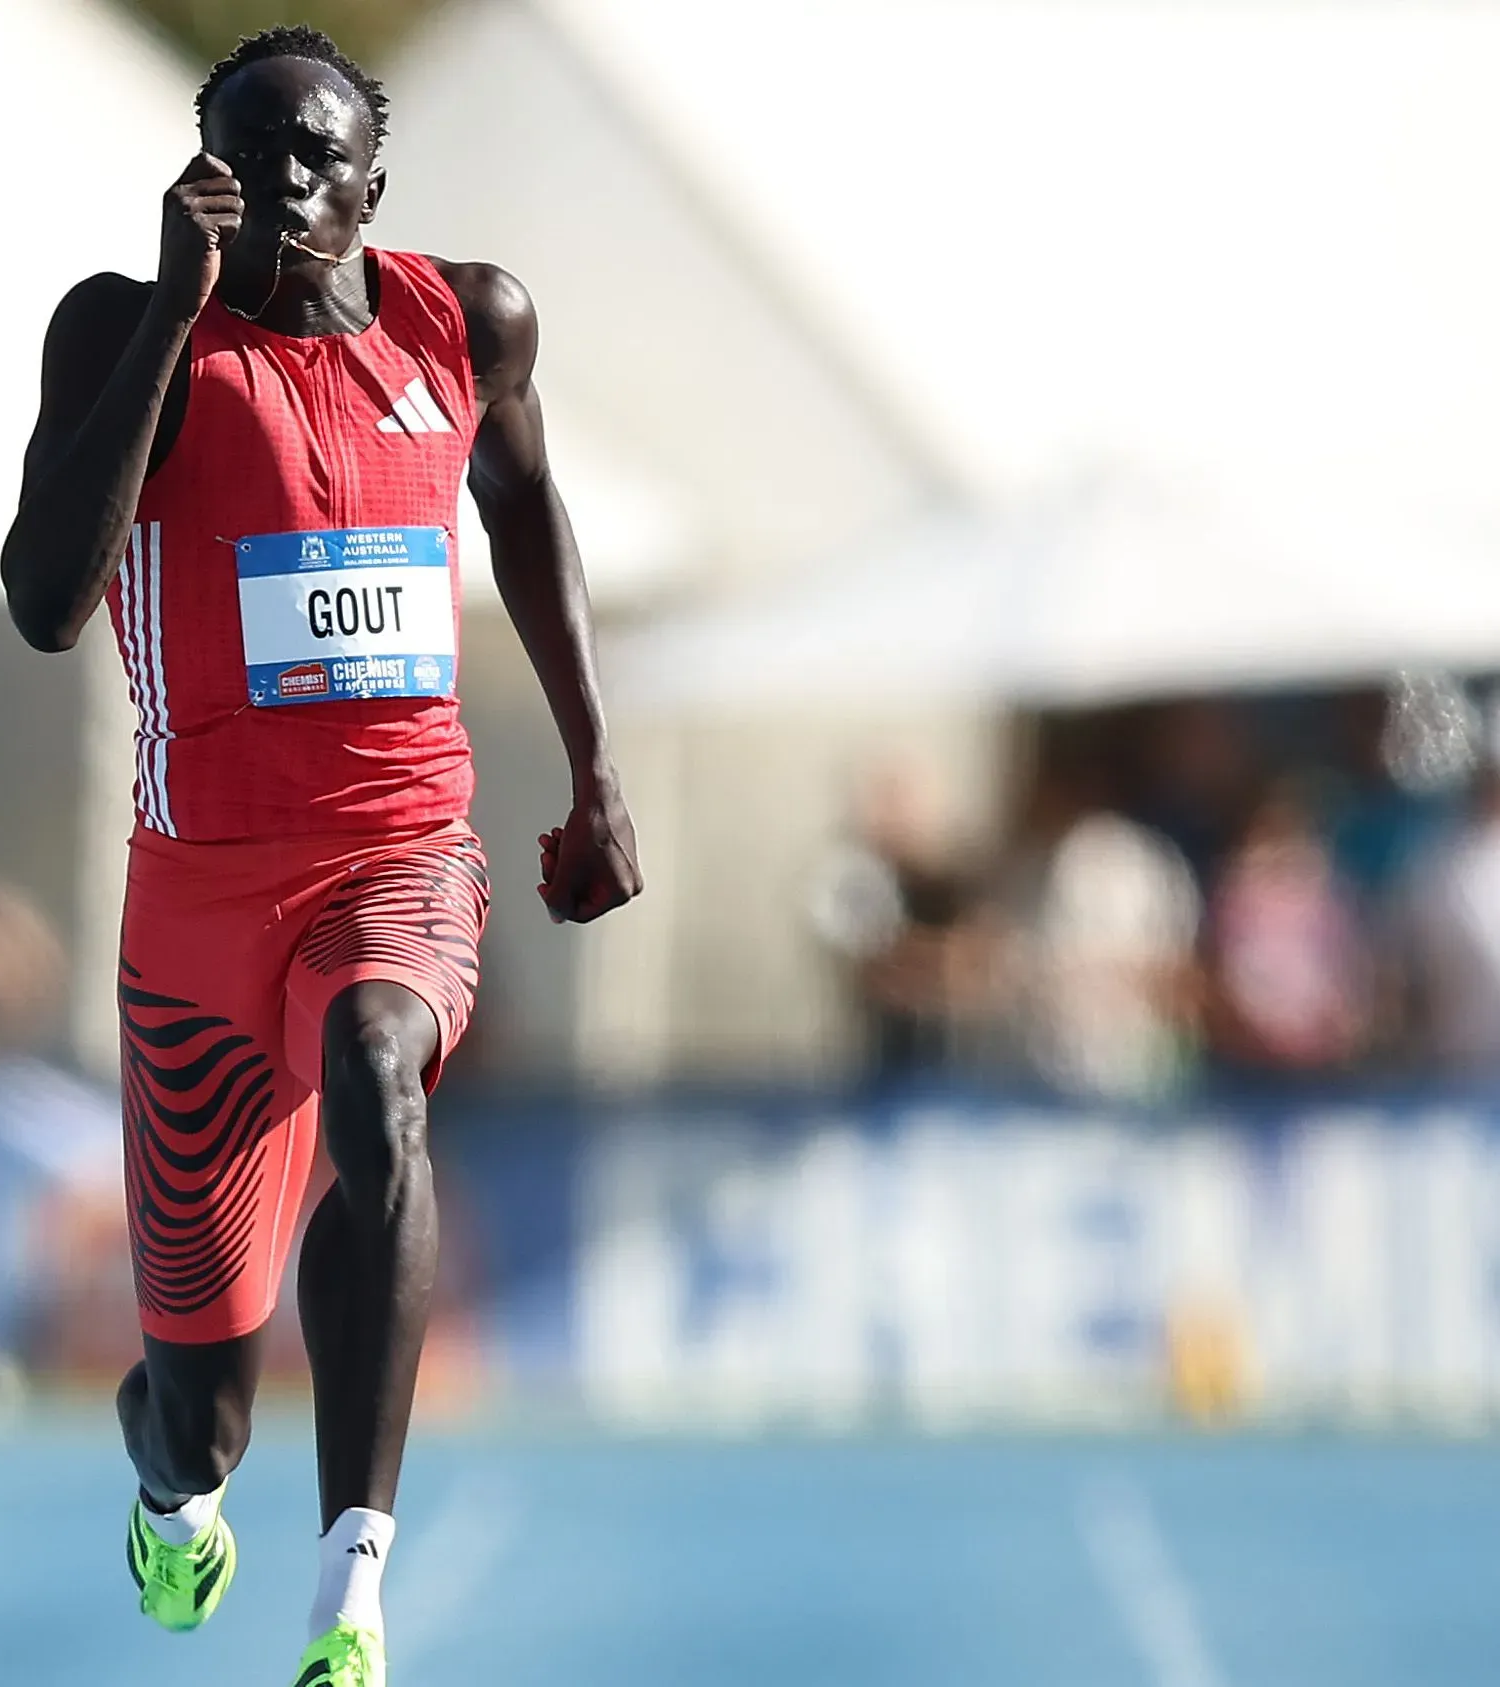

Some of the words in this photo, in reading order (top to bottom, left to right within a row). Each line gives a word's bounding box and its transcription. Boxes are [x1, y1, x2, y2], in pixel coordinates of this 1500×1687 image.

[346, 532, 403, 544] WESTERN
[342, 544, 408, 556] AUSTRALIA
[308, 586, 403, 639] GOUT
[332, 658, 406, 681] CHEMIST
[281, 674, 324, 687] CHEMIST
